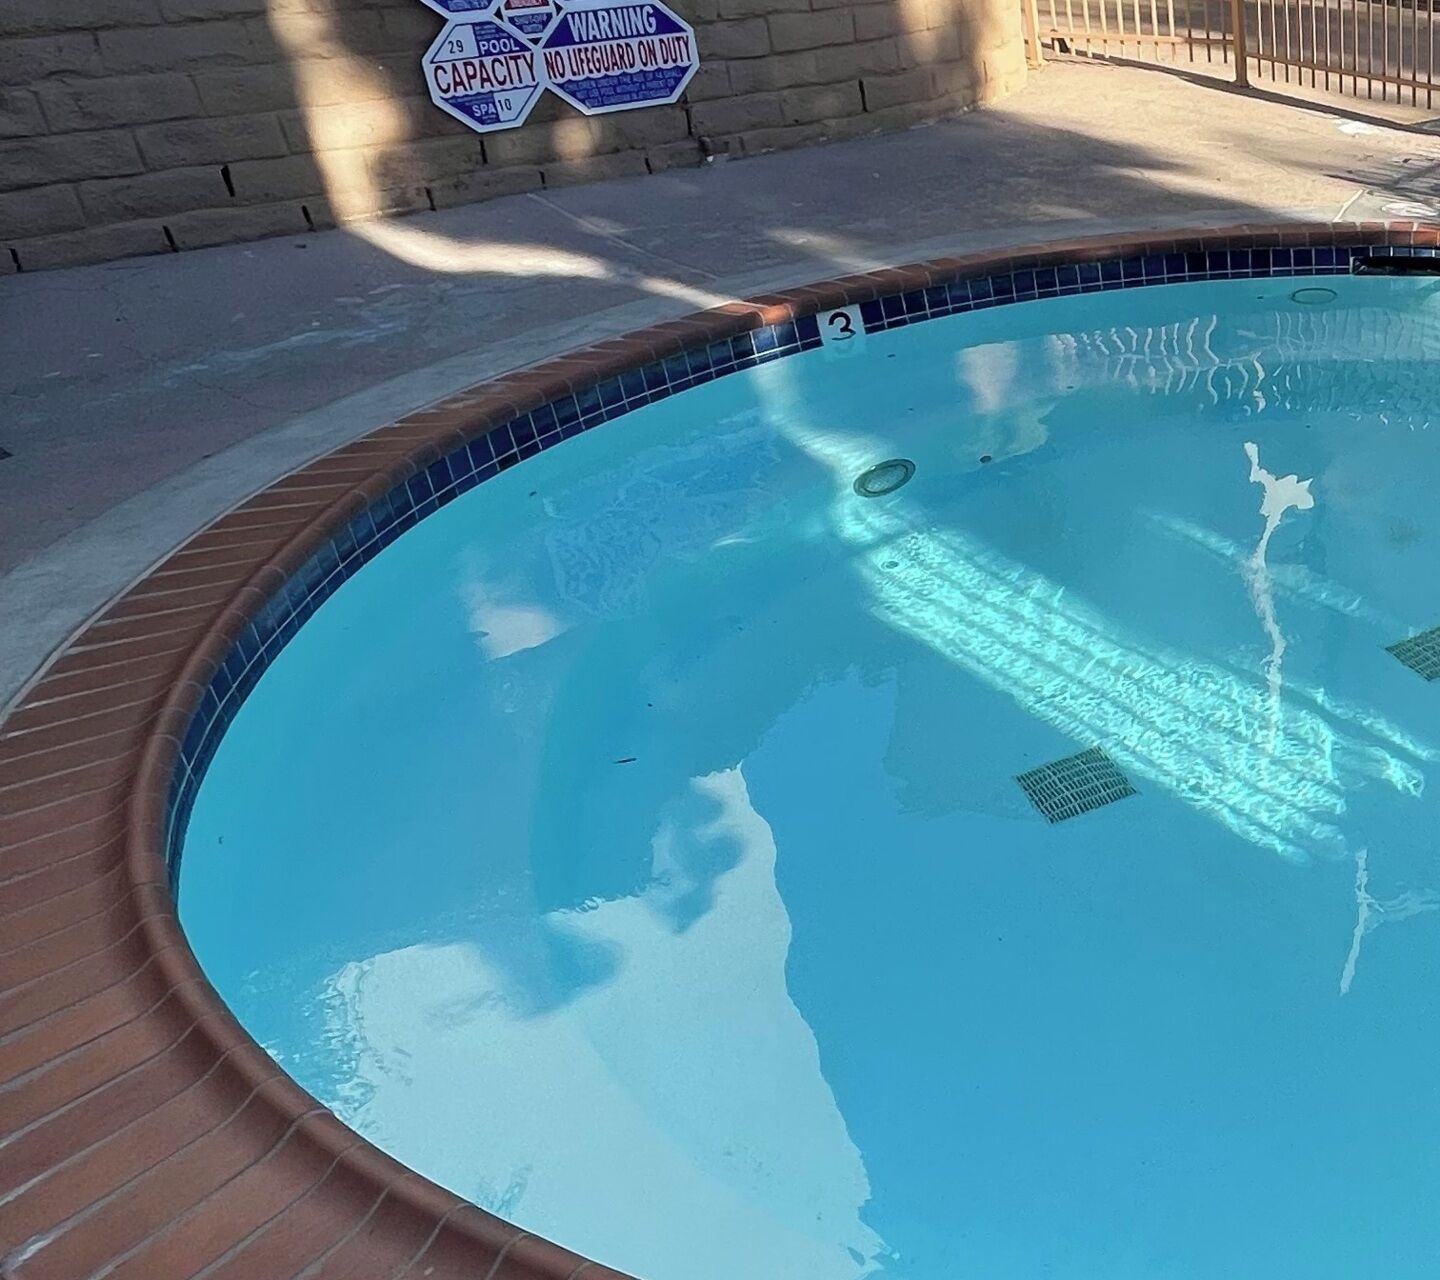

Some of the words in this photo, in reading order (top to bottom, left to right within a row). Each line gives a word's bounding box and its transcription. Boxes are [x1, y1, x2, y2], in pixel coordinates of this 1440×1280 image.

[567, 6, 657, 42] WARNING
[448, 40, 464, 54] 29
[479, 39, 519, 55] POOL
[544, 49, 566, 80] NO
[567, 42, 635, 76] LIFEGUARD
[638, 40, 658, 67] ON
[659, 35, 691, 64] DUTY
[433, 52, 536, 94] CAPACITY
[472, 102, 496, 117] SPA
[499, 98, 512, 113] 10
[828, 311, 856, 341] 3
